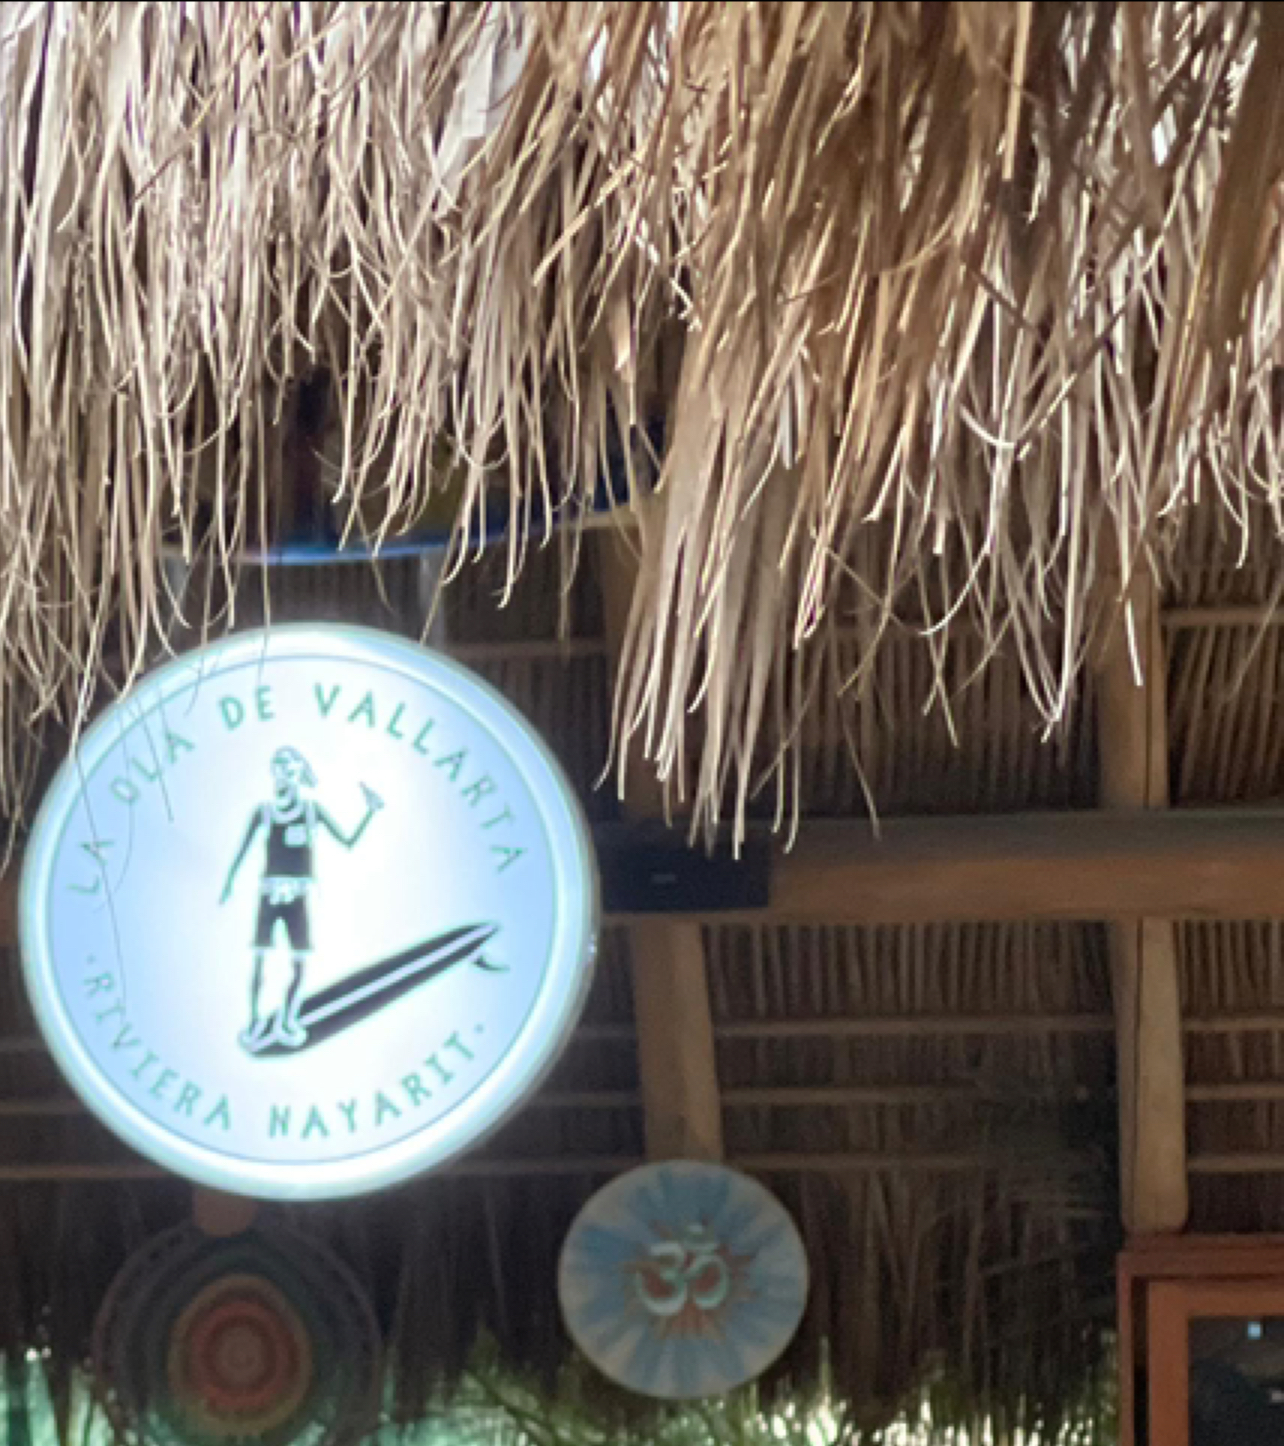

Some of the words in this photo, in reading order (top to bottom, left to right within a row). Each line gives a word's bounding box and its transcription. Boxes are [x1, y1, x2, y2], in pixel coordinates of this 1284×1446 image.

[67, 834, 114, 897] LA
[110, 729, 196, 806] OLA
[218, 685, 277, 731] DE
[313, 682, 528, 874] VALLARTA
[84, 970, 231, 1132] RIVIERA
[268, 1031, 476, 1140] NAYARIT
